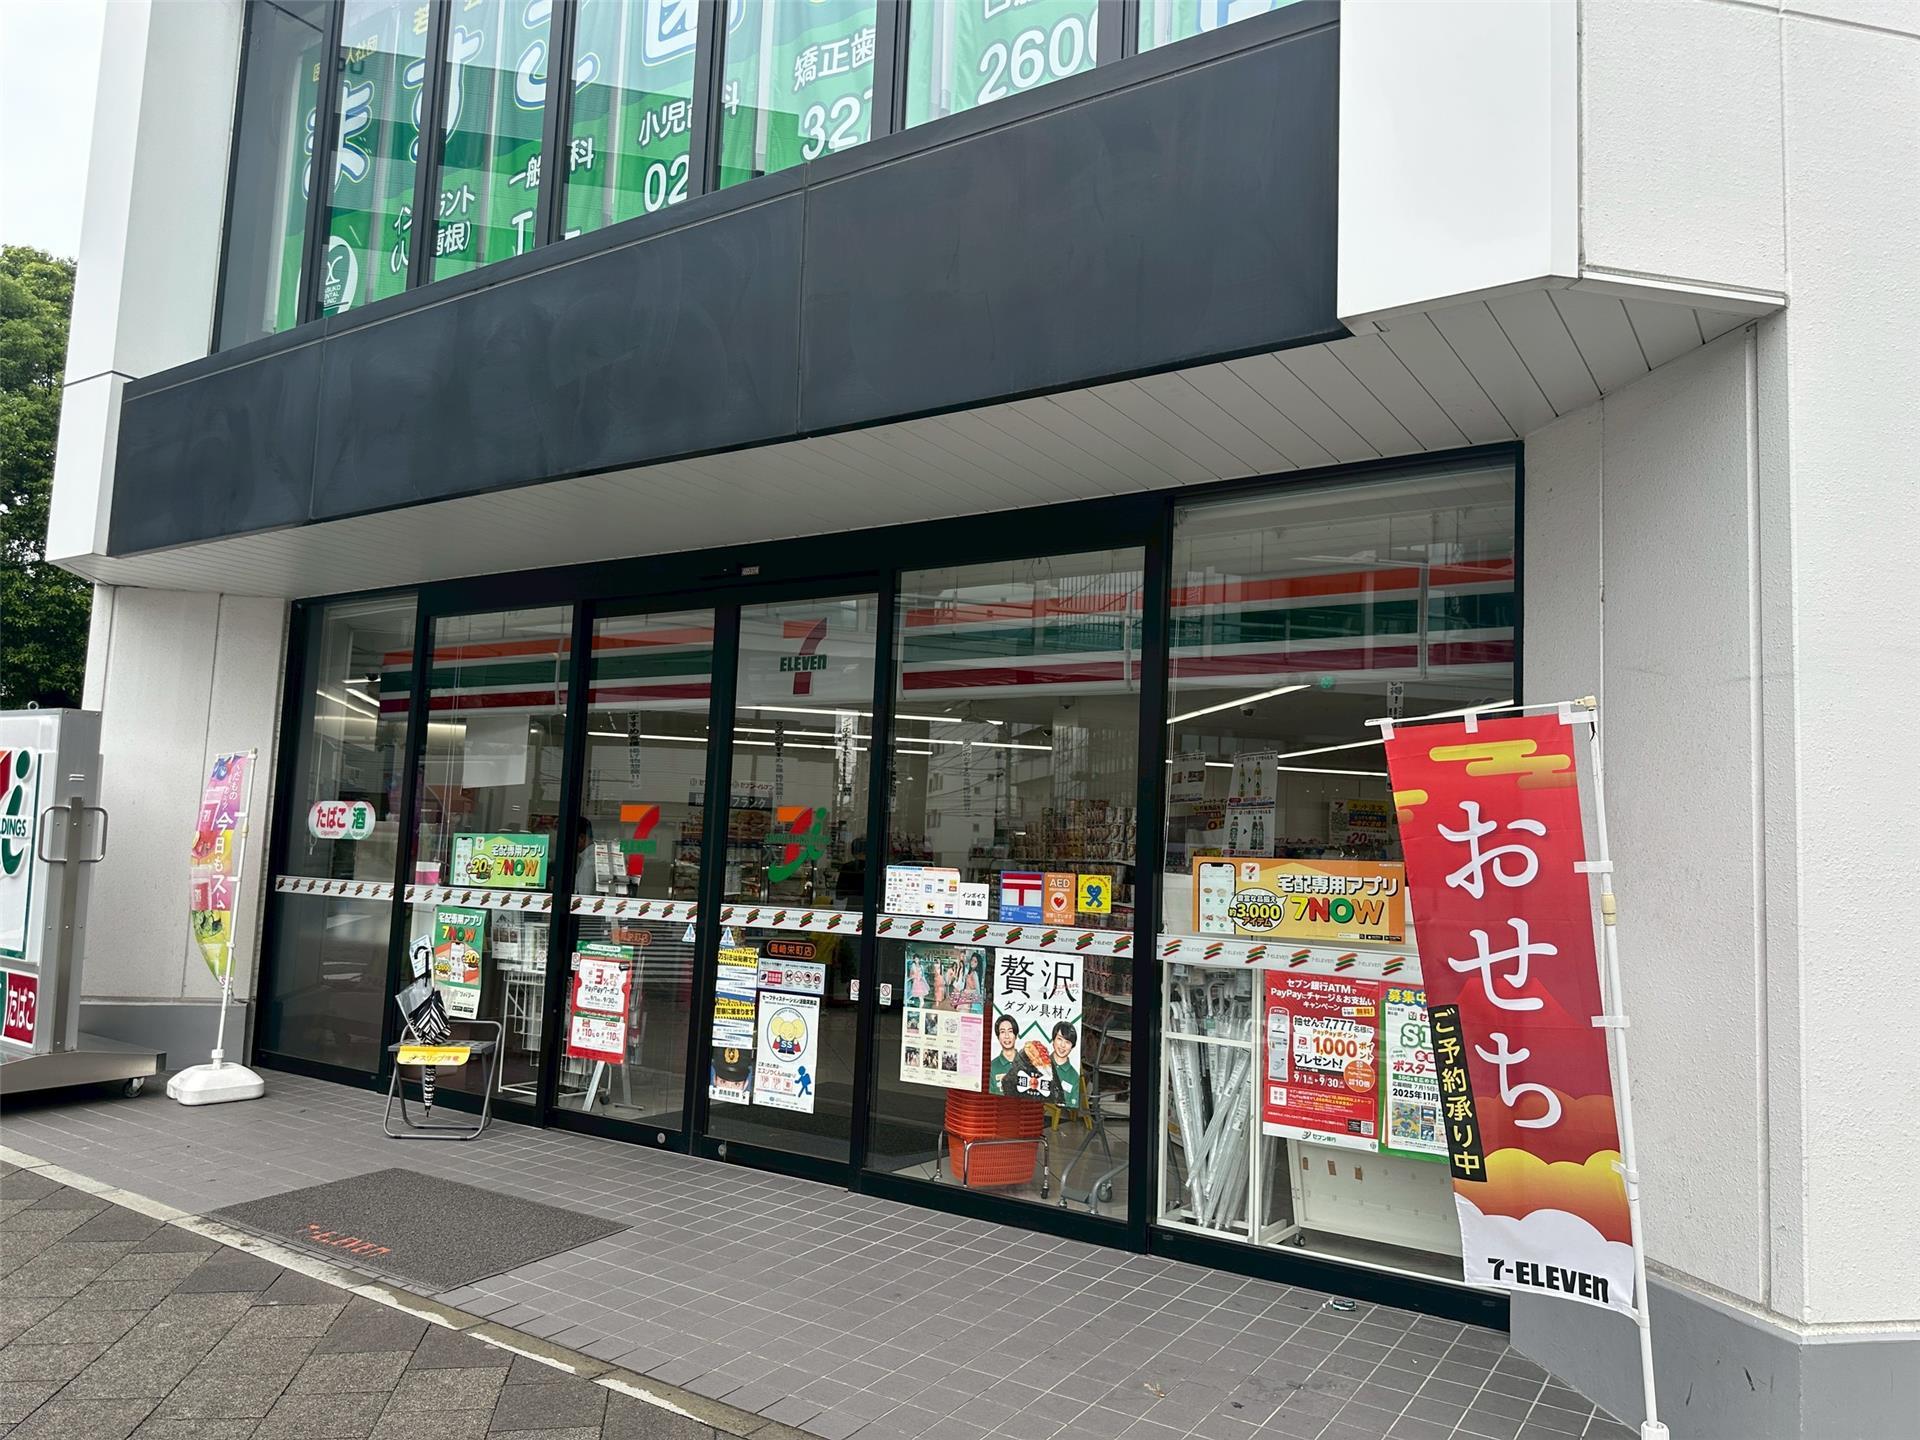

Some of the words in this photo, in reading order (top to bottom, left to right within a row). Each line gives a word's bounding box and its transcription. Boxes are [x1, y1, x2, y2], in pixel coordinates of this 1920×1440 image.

[802, 88, 872, 161] 32
[509, 138, 594, 189] 一般科
[315, 805, 347, 829] たばこ
[351, 806, 368, 830] 酒
[496, 857, 539, 878] 7NOW
[1049, 878, 1071, 888] AED
[1277, 873, 1399, 897] 宅配専用アプリ
[962, 892, 986, 900] インボイス
[1290, 895, 1385, 926] 7NOW
[1242, 916, 1273, 928] アイテム
[770, 943, 813, 957] 高崎栄町店
[1437, 801, 1562, 1129] おせち
[1000, 954, 1078, 1003] 贅沢
[1286, 978, 1357, 995] セブン銀行ATMで
[1303, 1000, 1341, 1011] キャンペーン
[1387, 988, 1427, 1006] 募集中
[6, 985, 36, 1031] たばこ
[1004, 1000, 1072, 1020] ダブル具材!
[780, 1040, 793, 1049] SS
[1313, 1036, 1358, 1058] 1,000
[1294, 1053, 1343, 1069] プレゼント!
[1393, 1060, 1437, 1075] ポスター
[1392, 1088, 1439, 1102] 2025年11月
[1434, 1007, 1480, 1175] ご予約承り中
